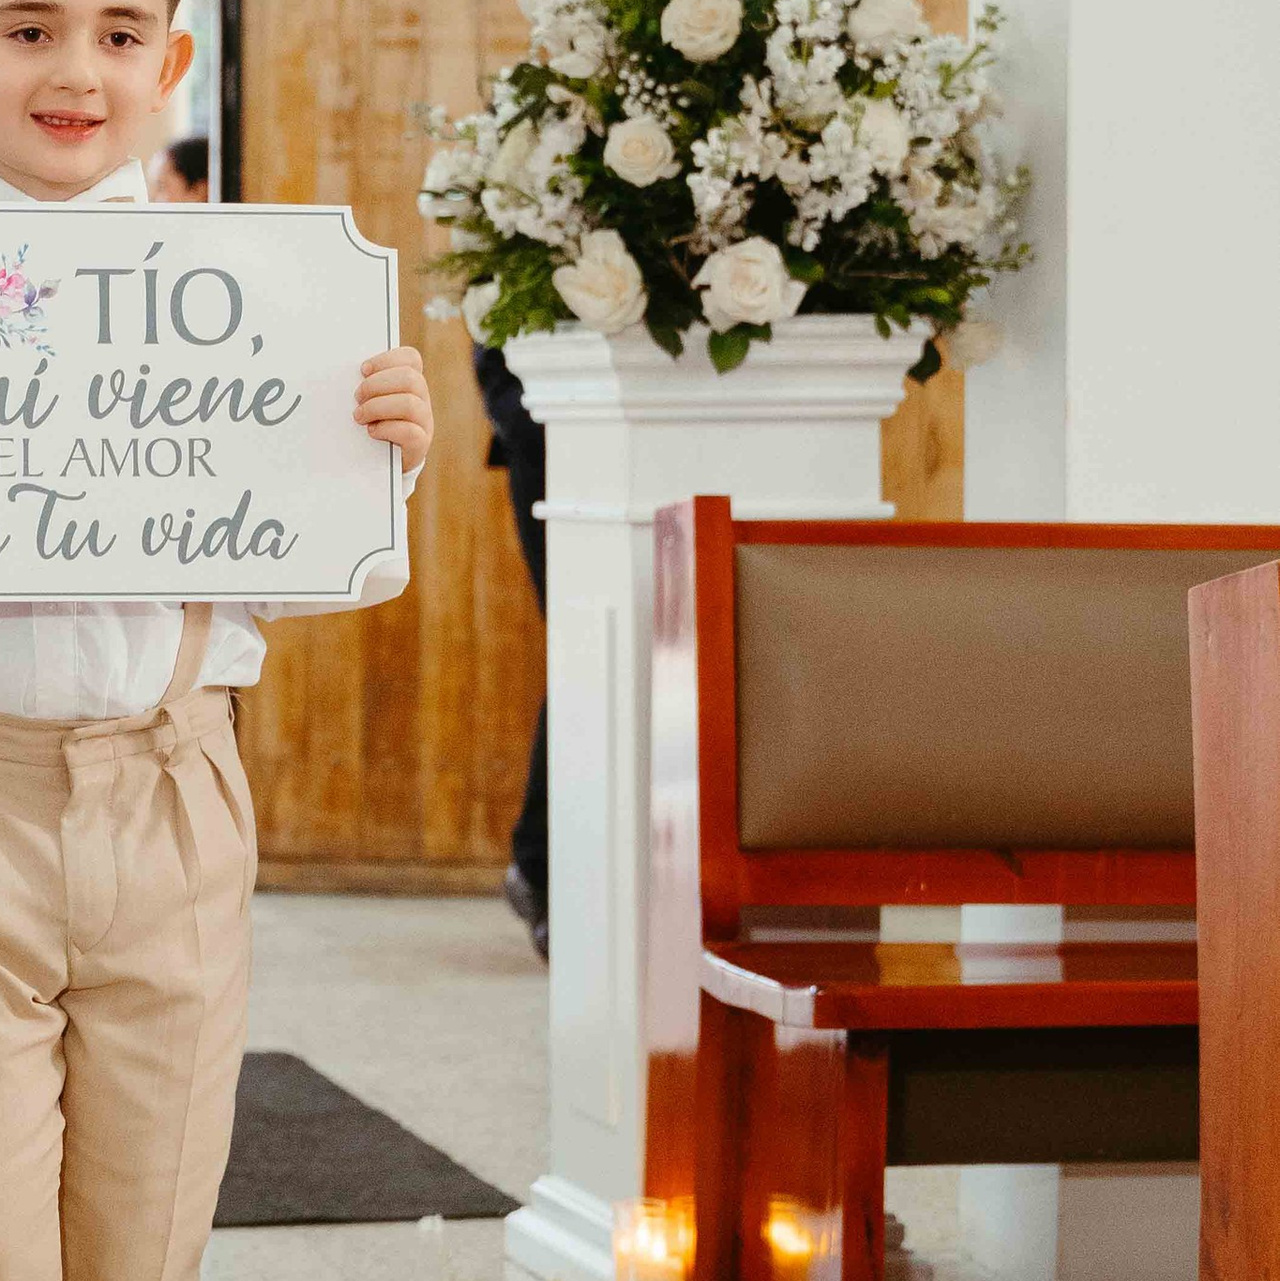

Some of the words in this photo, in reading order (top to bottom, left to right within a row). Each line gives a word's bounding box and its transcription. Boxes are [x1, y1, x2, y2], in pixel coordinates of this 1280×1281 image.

[74, 241, 264, 357] TÍO,
[88, 364, 302, 429] viene
[60, 437, 217, 478] AMOR
[7, 482, 117, 561] Tu
[142, 489, 300, 565] vida
